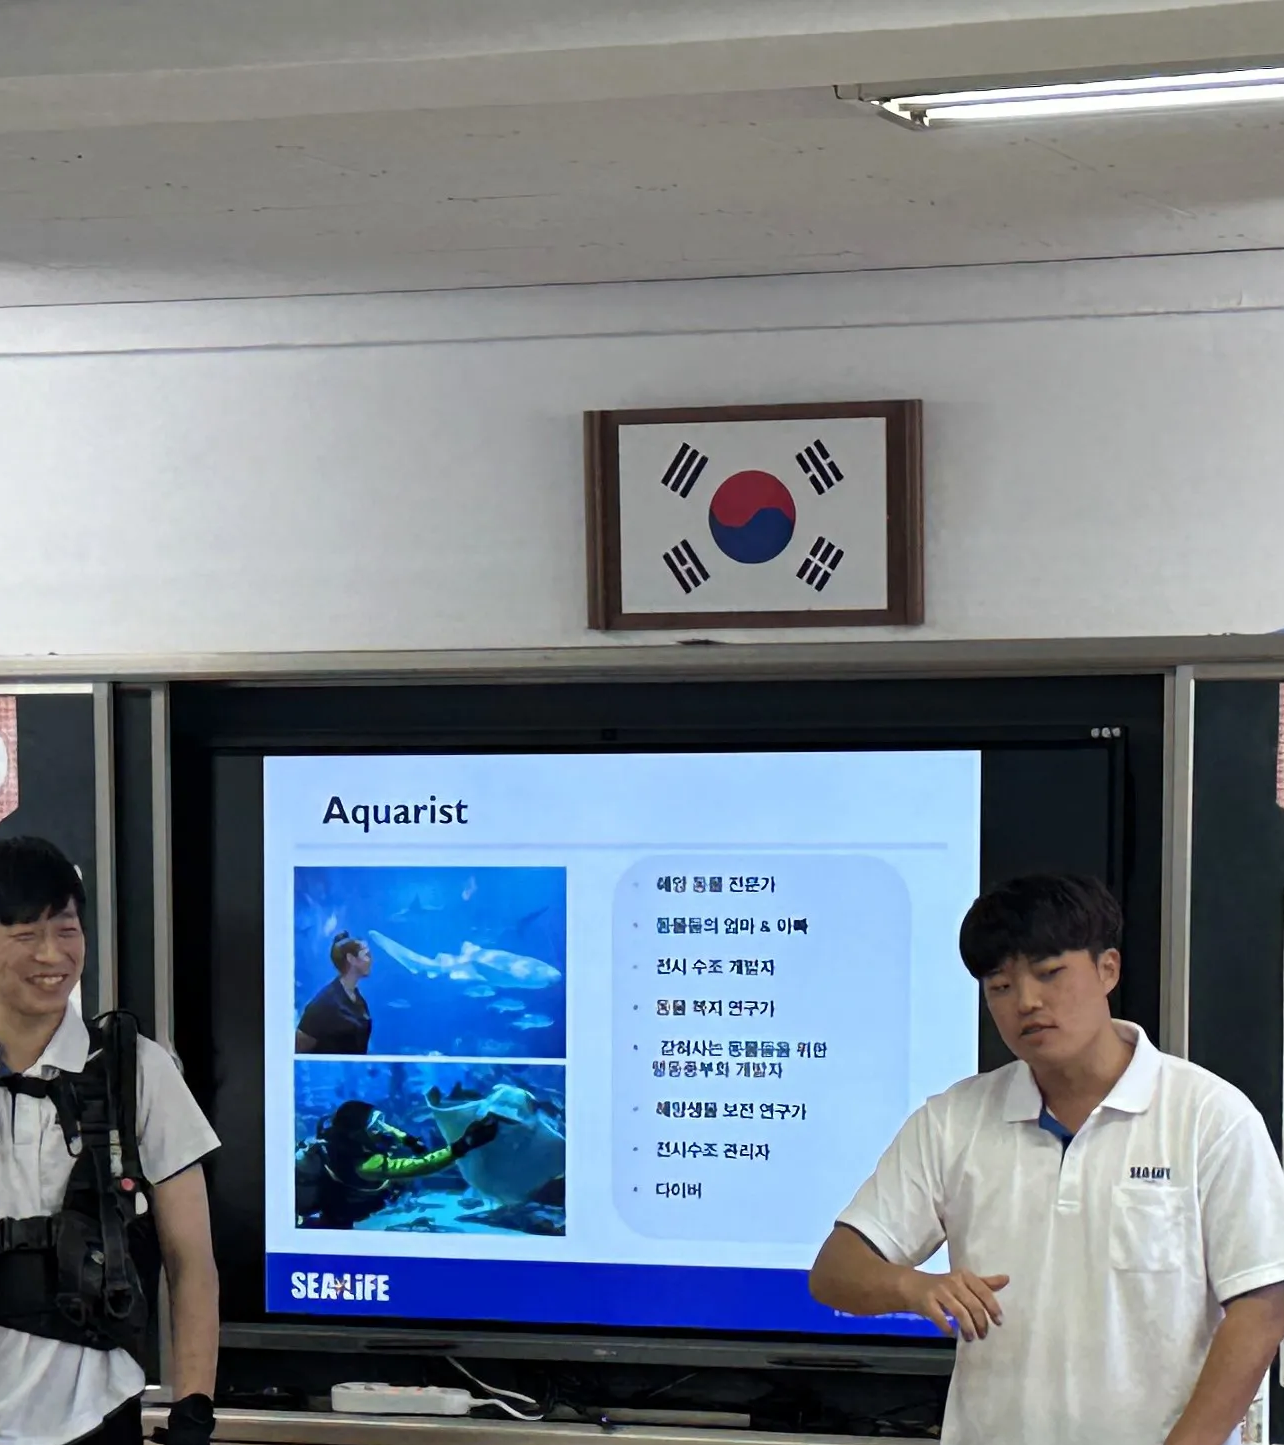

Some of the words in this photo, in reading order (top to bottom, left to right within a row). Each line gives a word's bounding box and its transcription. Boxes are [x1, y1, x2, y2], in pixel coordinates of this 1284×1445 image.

[322, 795, 468, 833] Aquarist
[656, 876, 687, 893] 해양
[692, 876, 723, 893] 동물
[729, 876, 776, 893] 전문가
[724, 917, 755, 934] 엄마
[760, 920, 771, 932] &
[777, 917, 808, 934] 아빠
[656, 958, 687, 976] 전시
[692, 959, 723, 975] 수조
[729, 959, 775, 976] 개발자
[656, 999, 686, 1016] 동물
[728, 1000, 775, 1017] 연구가
[797, 1041, 827, 1058] 위한
[736, 1062, 783, 1079] 개발자
[656, 1101, 717, 1118] 해양생물
[723, 1102, 754, 1119] 보전
[760, 1103, 806, 1120] 연구가
[657, 1141, 718, 1158] 전시수조
[723, 1143, 770, 1160] 관리자
[656, 1182, 702, 1199] 다이버
